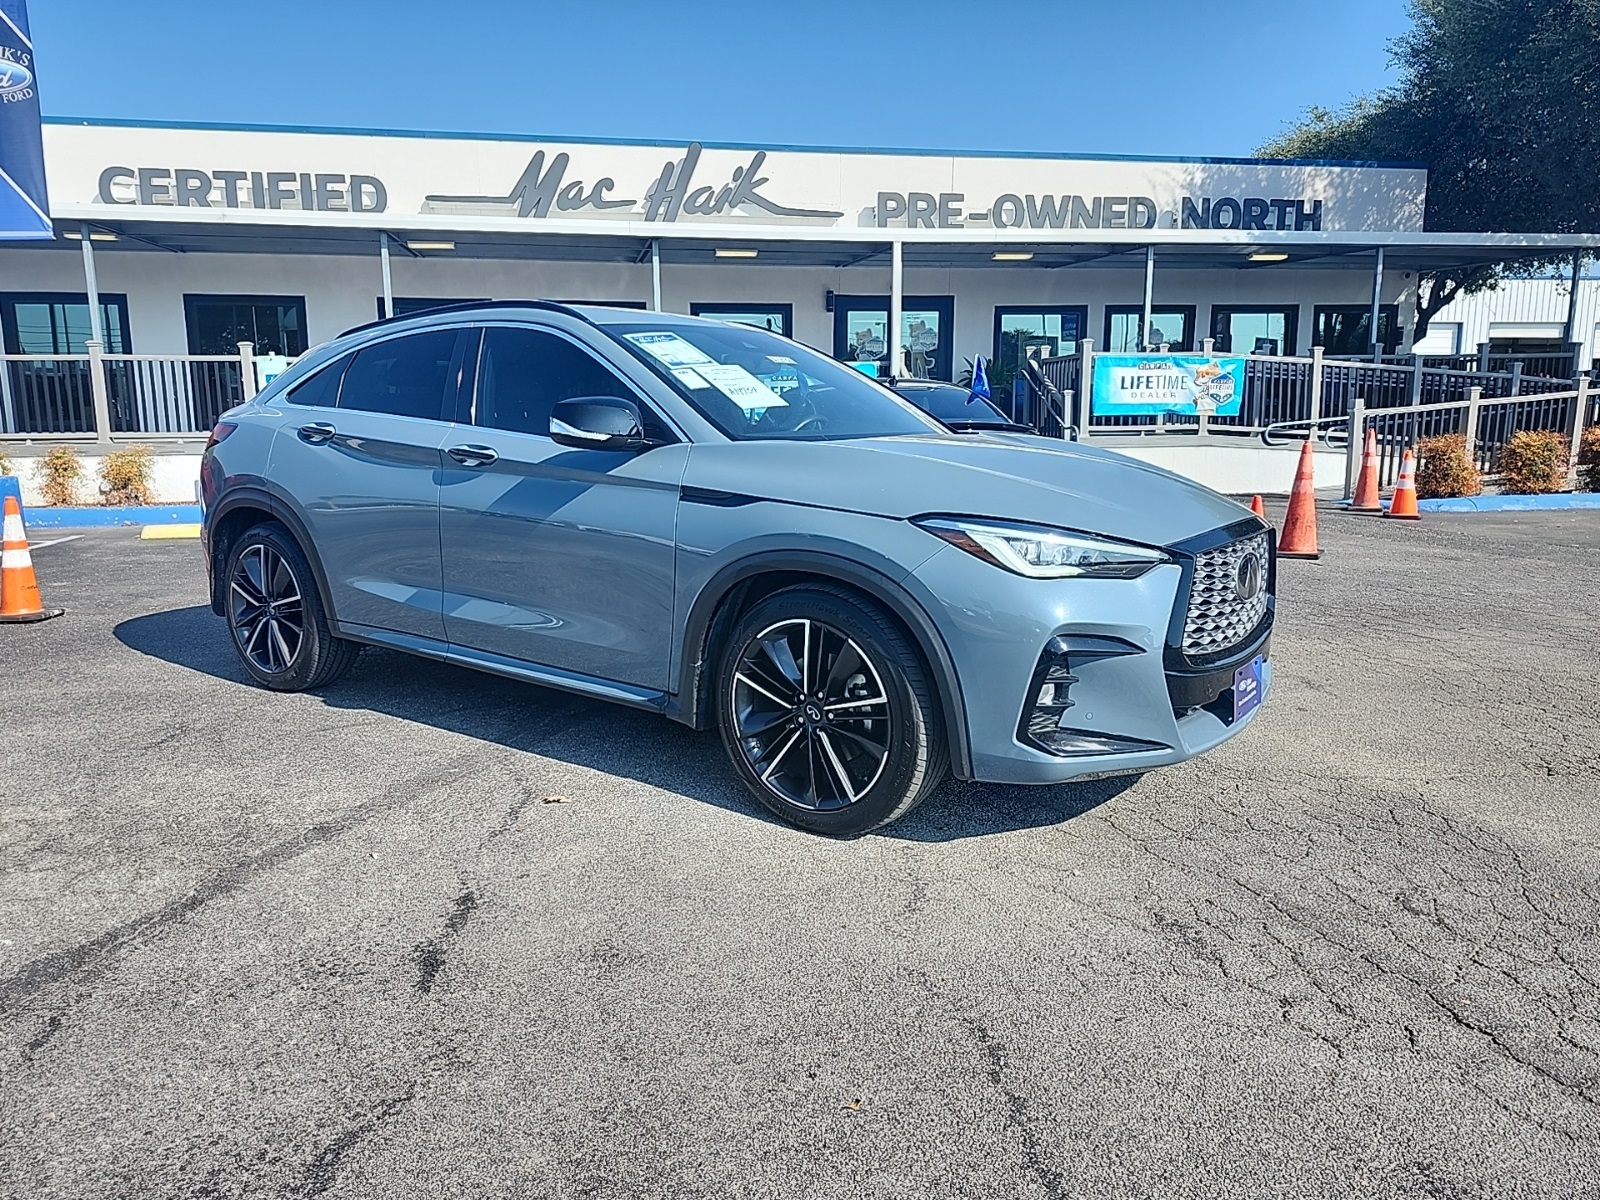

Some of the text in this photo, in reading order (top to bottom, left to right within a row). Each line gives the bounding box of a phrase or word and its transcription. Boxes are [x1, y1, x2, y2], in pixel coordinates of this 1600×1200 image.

[2, 88, 33, 103] FORD
[98, 166, 388, 213] CERTIFIED
[425, 142, 844, 222] Mac Haik
[876, 191, 1322, 231] PRE-OWNED NORTH
[1120, 375, 1188, 390] LIFETIME
[1131, 391, 1176, 399] DEALER
[843, 615, 873, 639] Sport
